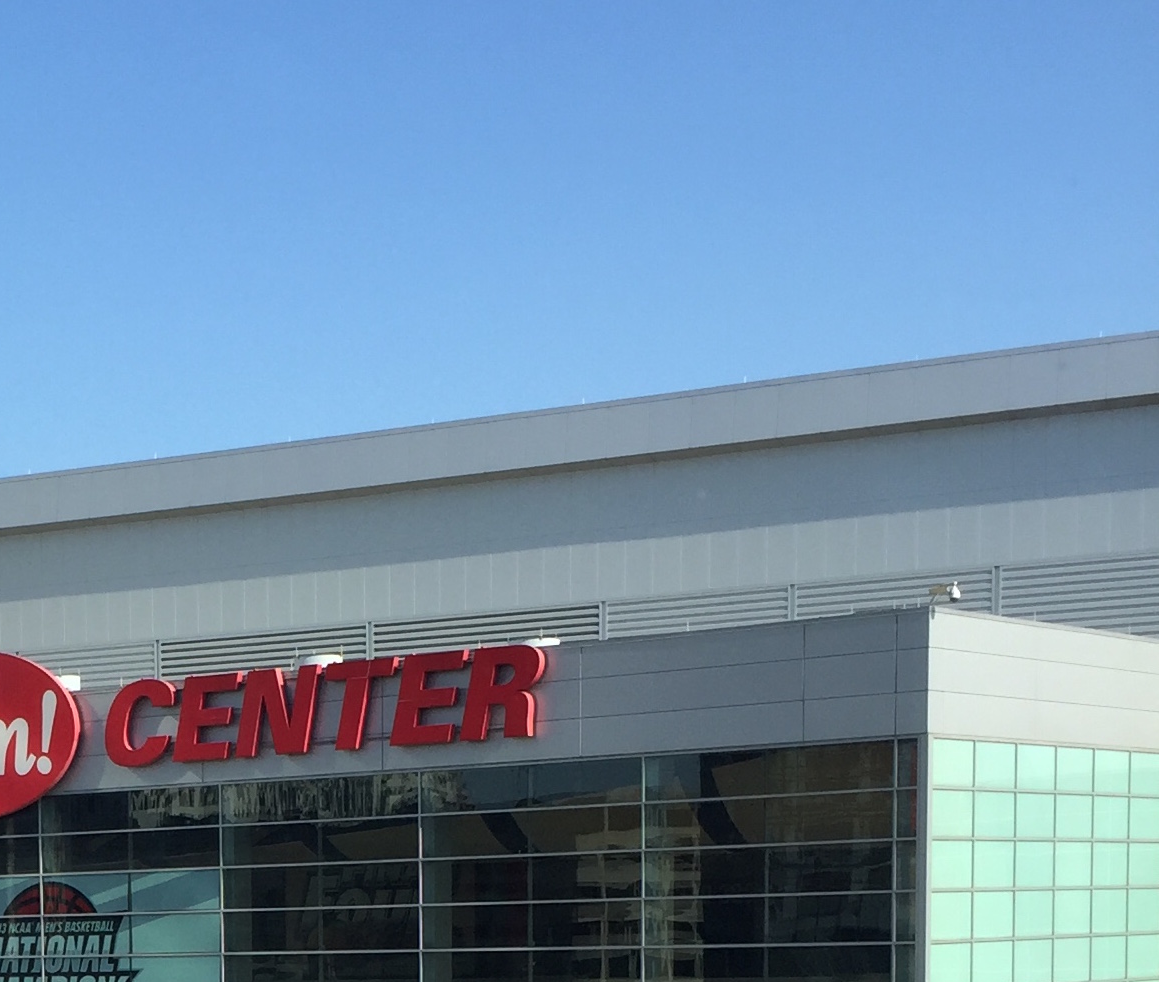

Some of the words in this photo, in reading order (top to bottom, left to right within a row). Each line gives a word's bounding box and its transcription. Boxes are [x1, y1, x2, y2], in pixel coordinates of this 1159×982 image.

[103, 644, 547, 767] CENTER
[8, 922, 32, 935] NCAA
[64, 920, 115, 934] BASKETBALL
